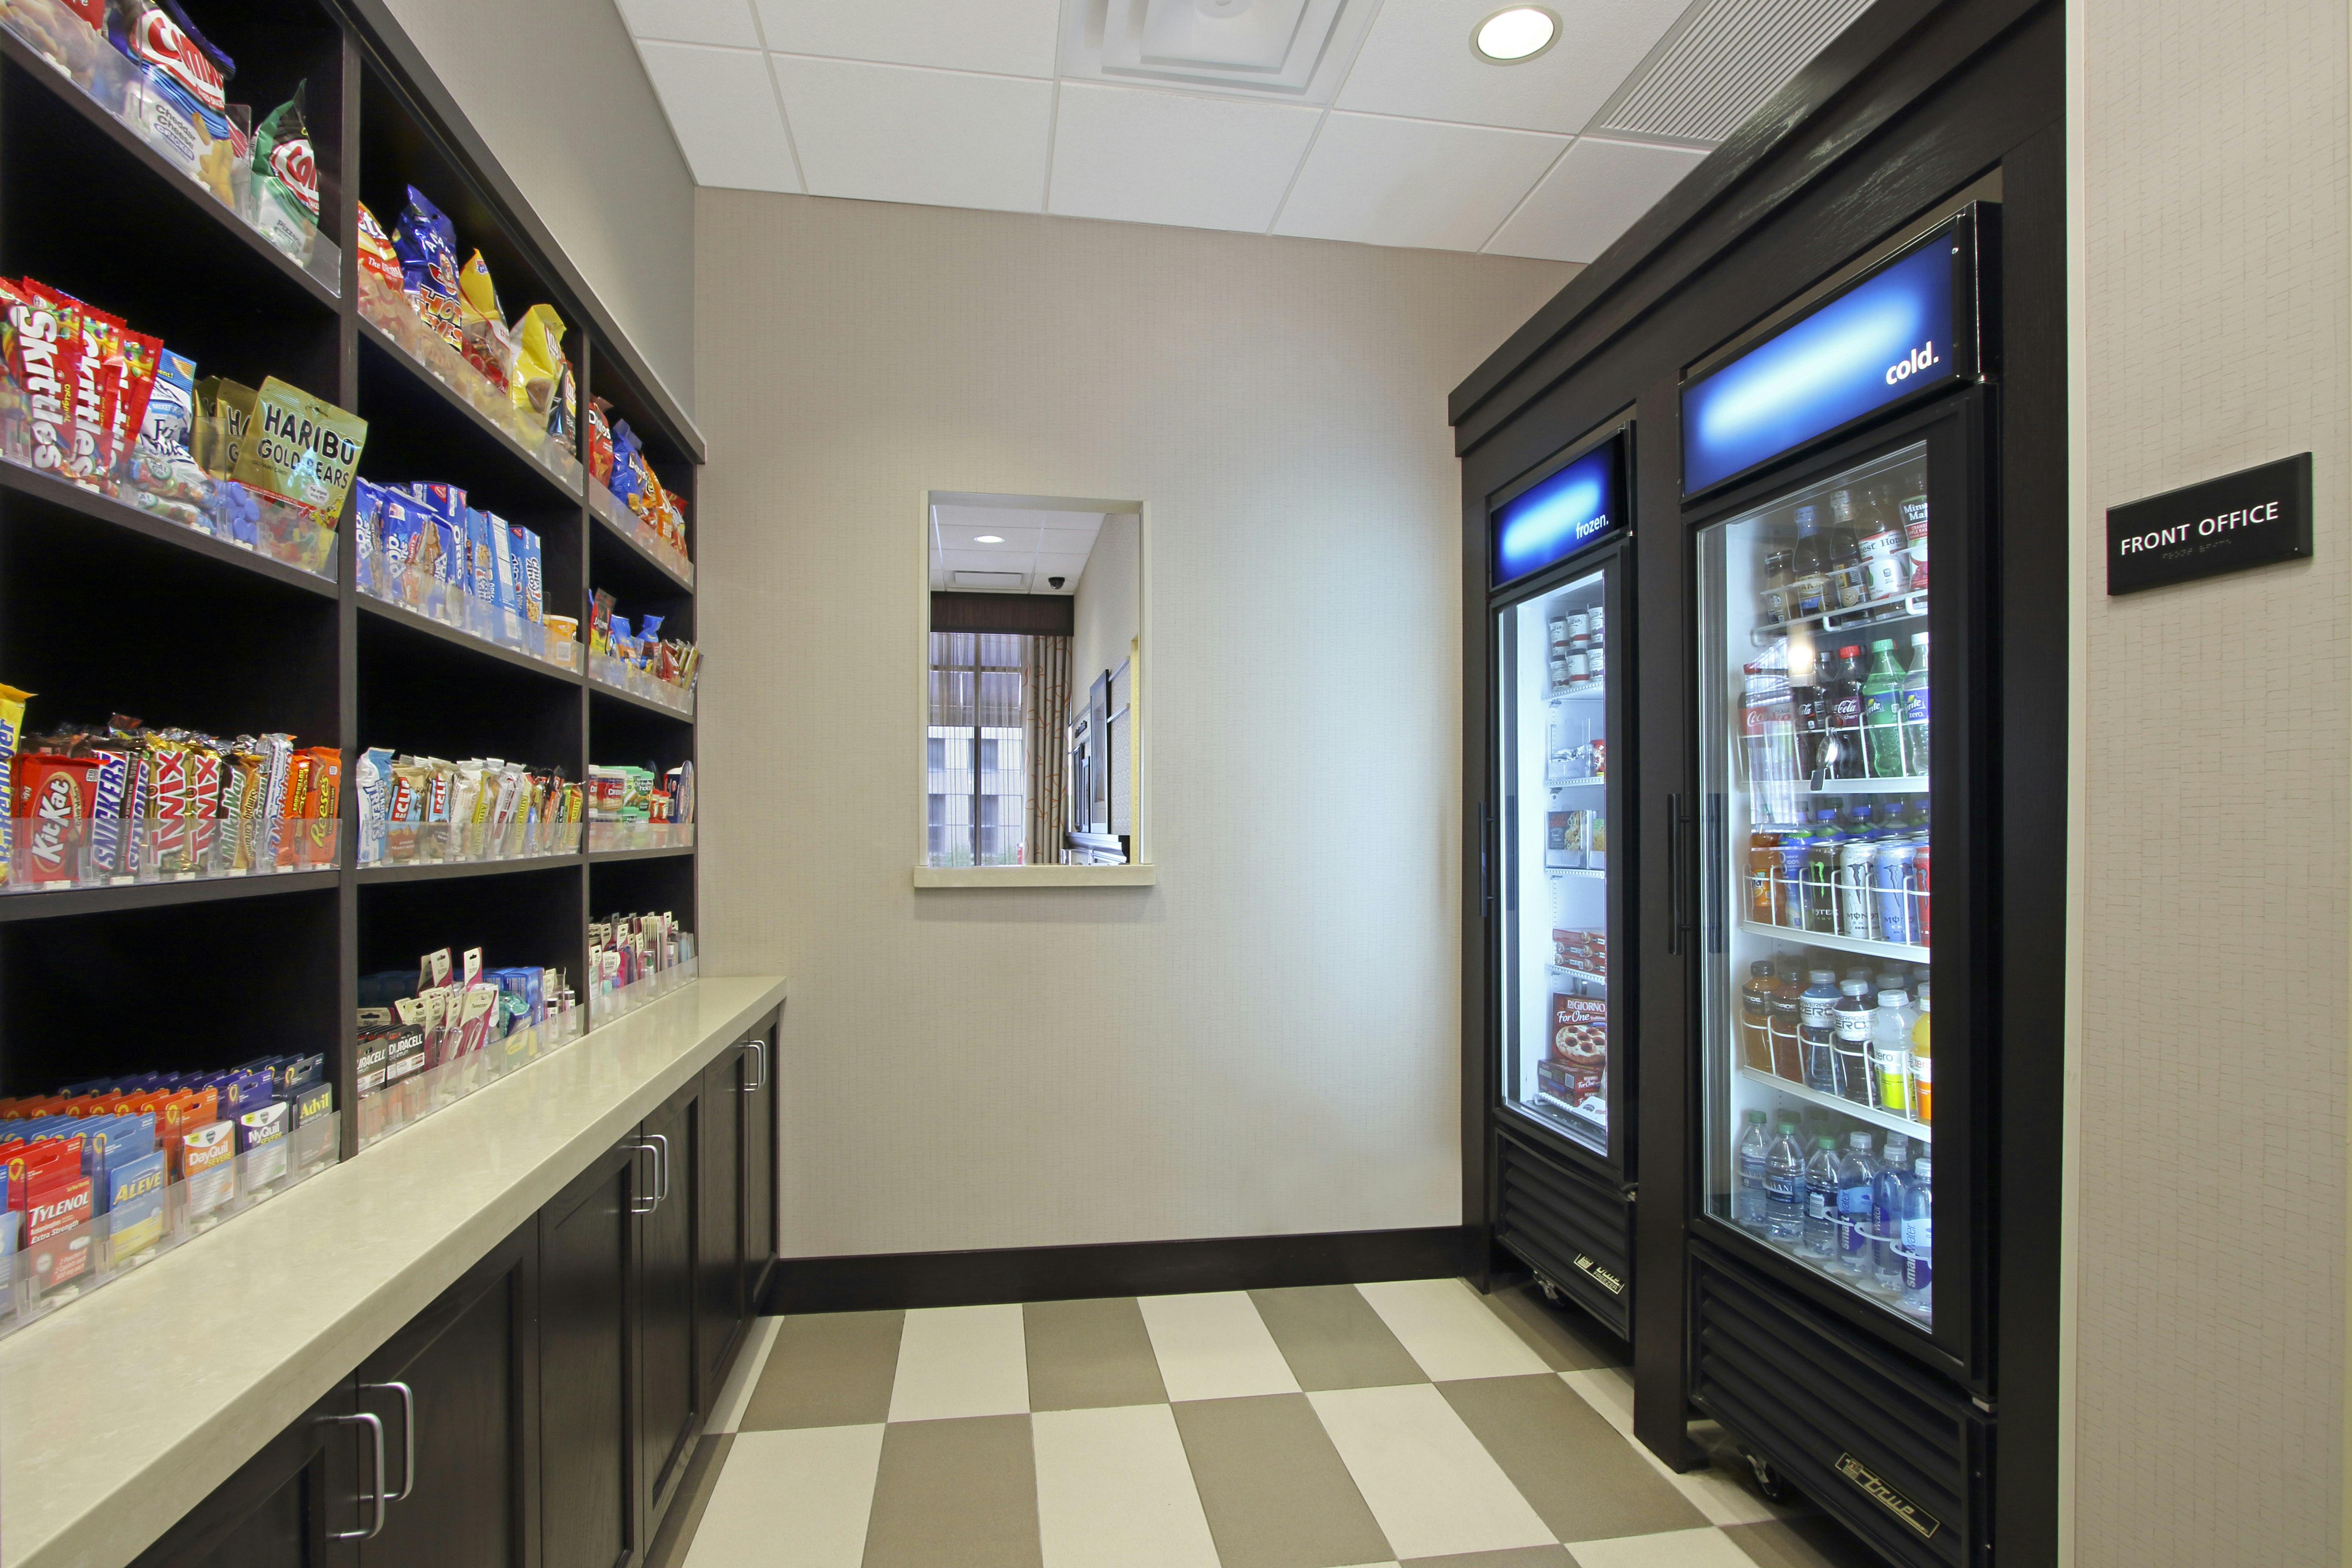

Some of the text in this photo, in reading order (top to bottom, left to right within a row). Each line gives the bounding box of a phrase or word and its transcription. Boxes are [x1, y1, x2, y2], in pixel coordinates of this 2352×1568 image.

[156, 104, 196, 141] Cheddar
[158, 115, 193, 149] Cheese
[368, 257, 381, 270] The
[421, 283, 462, 326] HOT
[1886, 341, 1939, 385] cold.
[9, 306, 64, 469] Skittles
[264, 403, 355, 466] HARIBO
[257, 438, 349, 490] GOLD BEARS
[1903, 503, 1928, 514] Minu
[1576, 514, 1609, 539] frozen.
[2121, 501, 2279, 556] FRONT OFFICE
[453, 524, 462, 580] OREO
[152, 751, 187, 866] TWIX
[190, 754, 220, 864] TWIX
[270, 752, 293, 837] Musketeers
[519, 796, 528, 817] VALLEY
[572, 798, 581, 818] VALLEY
[93, 753, 126, 868] SNICKERS
[310, 775, 329, 847] Reese's
[364, 781, 381, 840] TREATS
[1556, 1010, 1572, 1023] For
[1571, 1010, 1589, 1023] One
[1835, 1021, 1866, 1030] ERO
[357, 1049, 386, 1070] URACELL
[389, 1033, 423, 1056] DURACELL
[1874, 1051, 1893, 1062] zero
[300, 1093, 329, 1119] Advil
[248, 1121, 280, 1143] NyQuil
[260, 1131, 282, 1144] SEVERE
[189, 1141, 228, 1166] DayQuil
[208, 1152, 232, 1168] SEVERE
[113, 1171, 161, 1207] ALEVE
[29, 1191, 89, 1228] TYLENOL
[31, 1219, 80, 1244] Extra Strength
[1592, 1271, 1618, 1290] FREEZER
